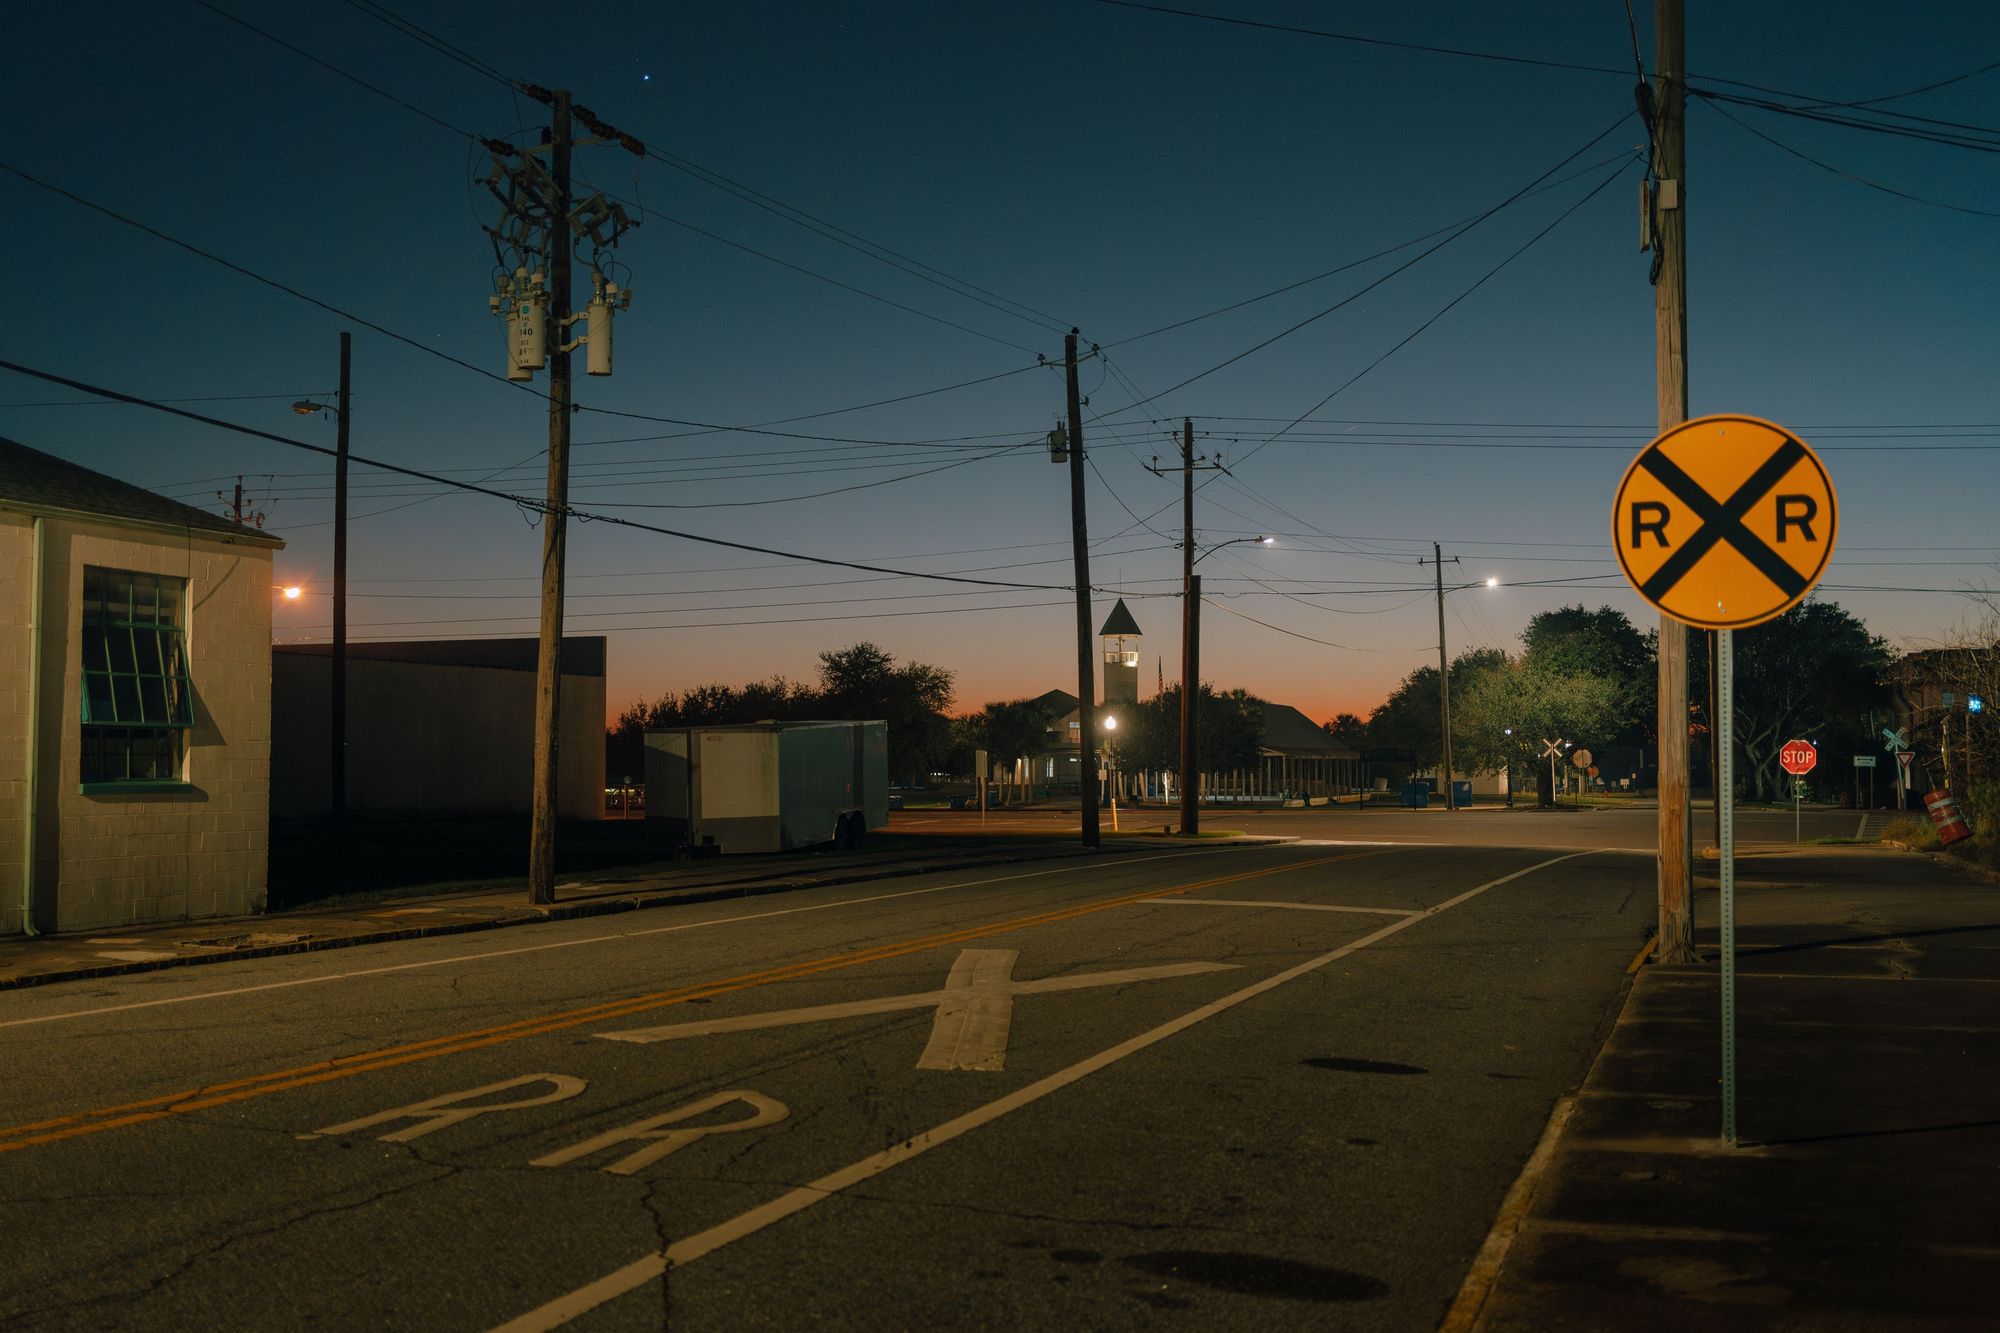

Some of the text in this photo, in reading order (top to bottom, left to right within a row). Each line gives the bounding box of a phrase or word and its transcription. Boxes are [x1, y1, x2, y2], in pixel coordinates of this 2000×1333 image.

[1632, 494, 1817, 549] R R
[1783, 750, 1814, 764] STOP
[296, 1072, 790, 1176] R R
